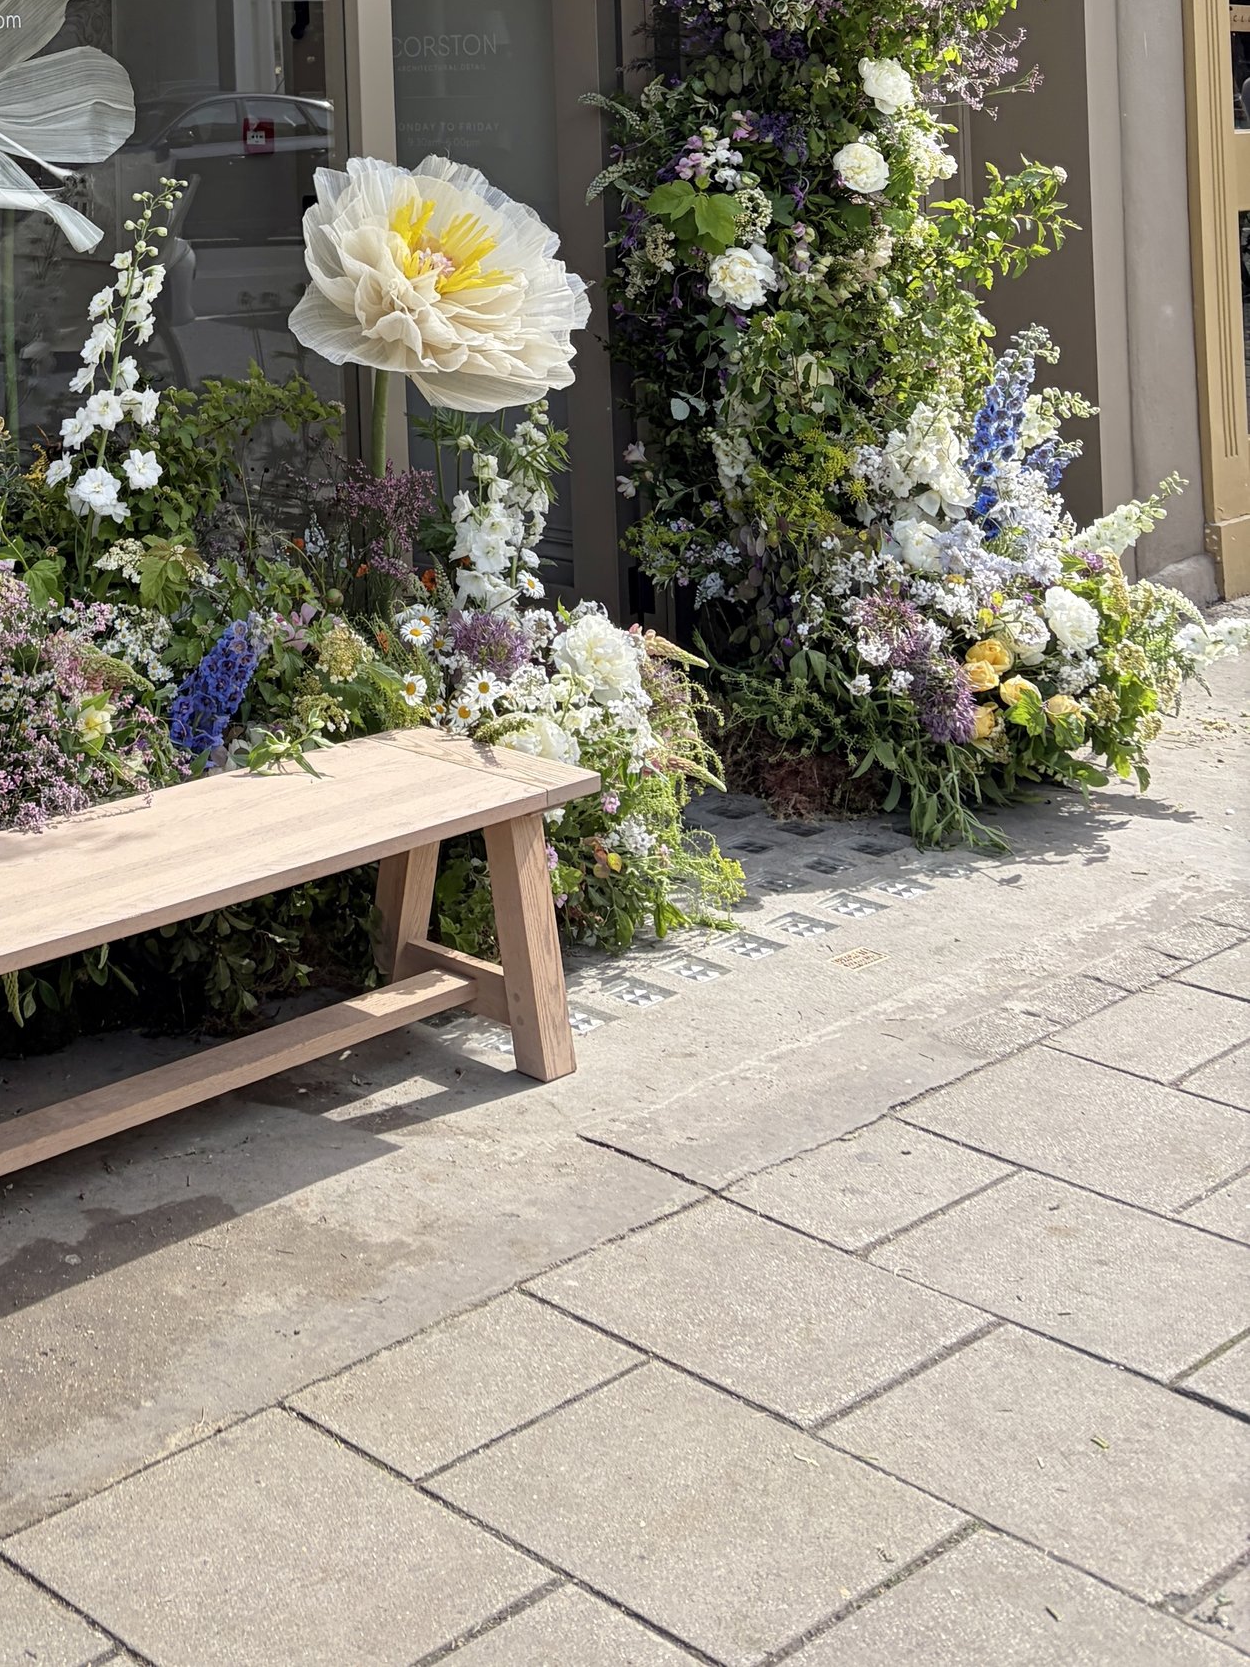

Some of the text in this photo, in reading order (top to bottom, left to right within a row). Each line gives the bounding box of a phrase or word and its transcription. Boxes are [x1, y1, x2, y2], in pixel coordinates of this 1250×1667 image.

[393, 32, 498, 58] CORSTON
[398, 121, 500, 132] ONDAY TO FRIDAY
